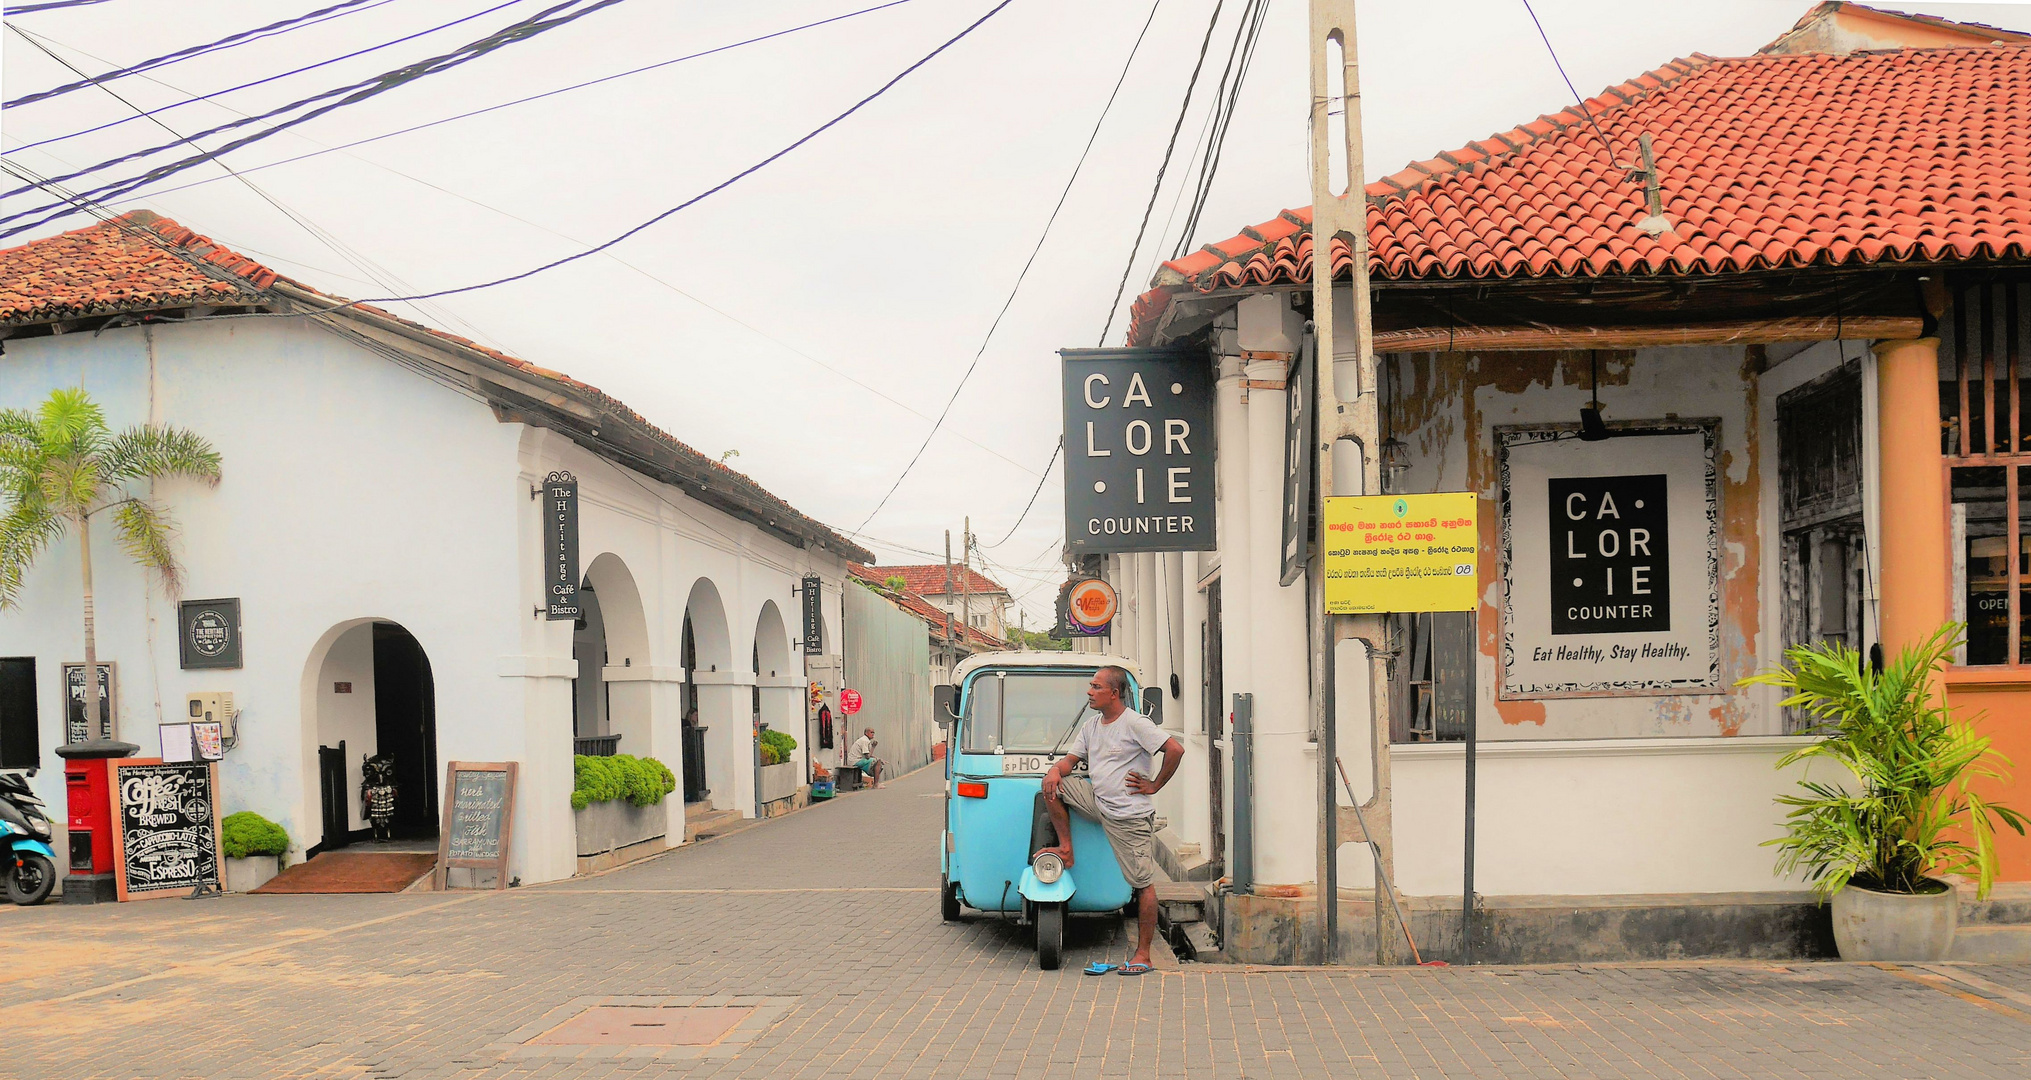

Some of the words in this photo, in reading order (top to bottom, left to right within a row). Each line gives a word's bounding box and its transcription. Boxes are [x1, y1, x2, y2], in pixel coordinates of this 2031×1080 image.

[1086, 419, 1191, 457] LOR
[551, 488, 571, 498] The
[1088, 516, 1194, 535] COUNTER
[556, 501, 567, 581] Heritage
[1567, 528, 1652, 559] LOR
[1455, 565, 1472, 575] 08
[552, 585, 575, 595] Café
[560, 596, 567, 604] &
[551, 605, 577, 615] Bistro
[1567, 604, 1653, 621] COUNTER
[1533, 647, 1553, 661] Eat
[1556, 645, 1605, 664] Healthy,
[1610, 644, 1638, 663] Stay
[1641, 642, 1690, 661] Healthy.
[1019, 758, 1040, 771] HO
[123, 775, 184, 817] Coffee
[139, 813, 177, 827] BREWED
[149, 860, 195, 880] ESPRESSO
